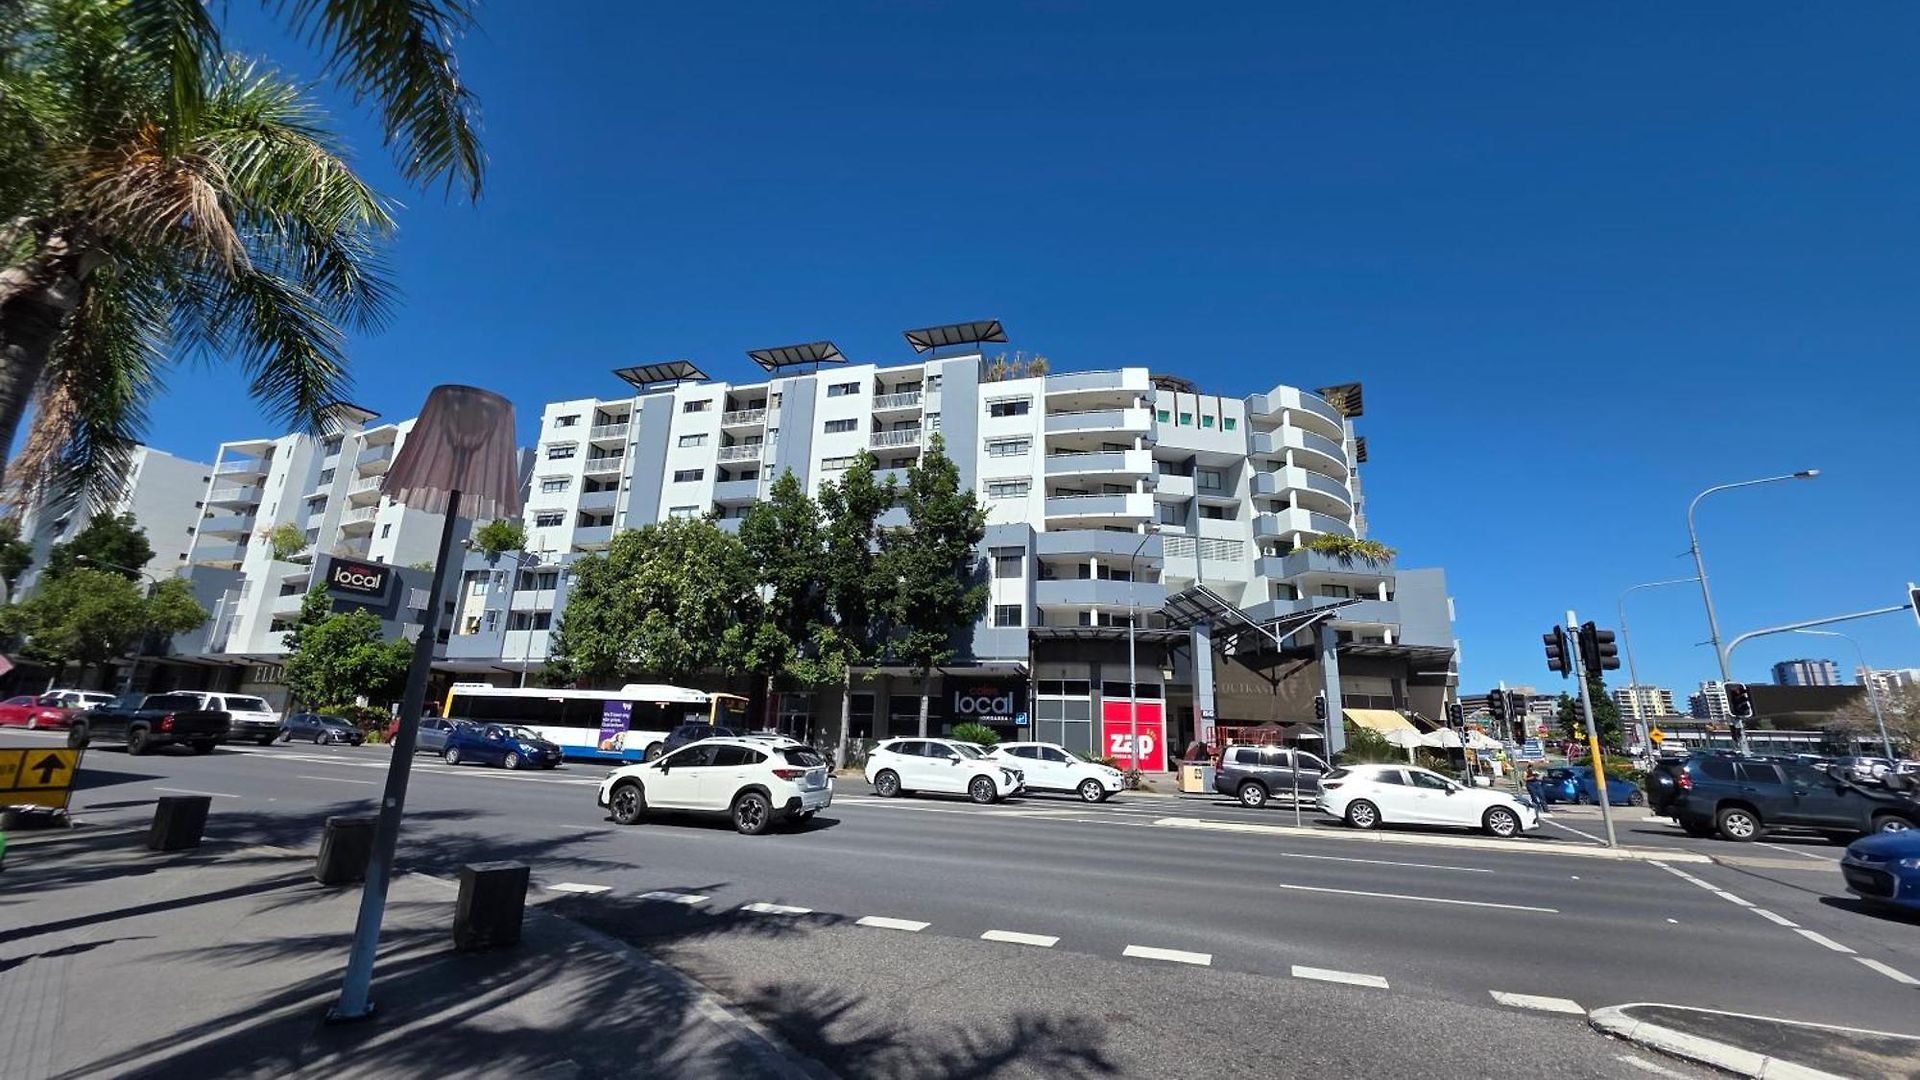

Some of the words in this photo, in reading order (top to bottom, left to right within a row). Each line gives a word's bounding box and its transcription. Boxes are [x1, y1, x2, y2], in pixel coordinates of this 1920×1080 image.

[334, 566, 381, 589] local
[954, 691, 1014, 714] local
[1111, 734, 1154, 760] zap
